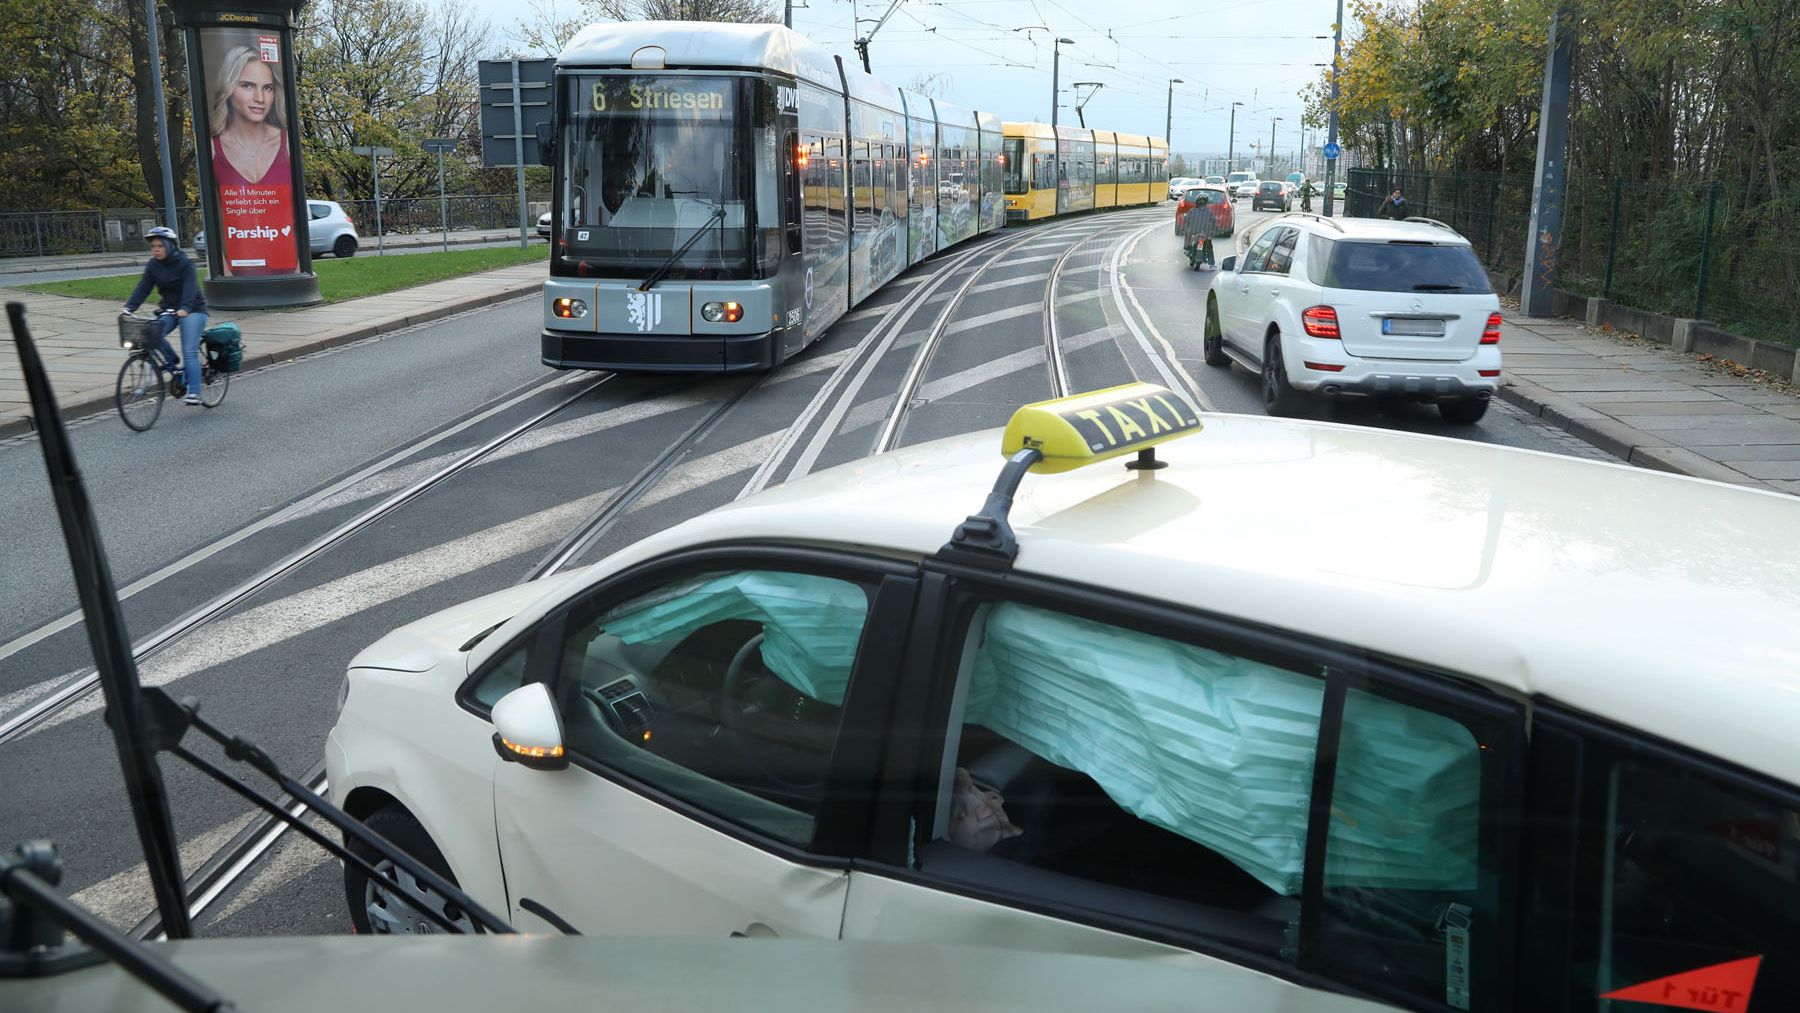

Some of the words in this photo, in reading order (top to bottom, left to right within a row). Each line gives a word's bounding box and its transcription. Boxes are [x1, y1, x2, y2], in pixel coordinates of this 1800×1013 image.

[592, 83, 606, 111] 6
[630, 85, 723, 109] Striesen
[785, 86, 799, 109] DVB
[247, 189, 277, 197] Minuten
[253, 198, 268, 206] sich
[226, 208, 247, 216] Single
[228, 226, 279, 241] Parship
[1078, 395, 1186, 446] TAXI
